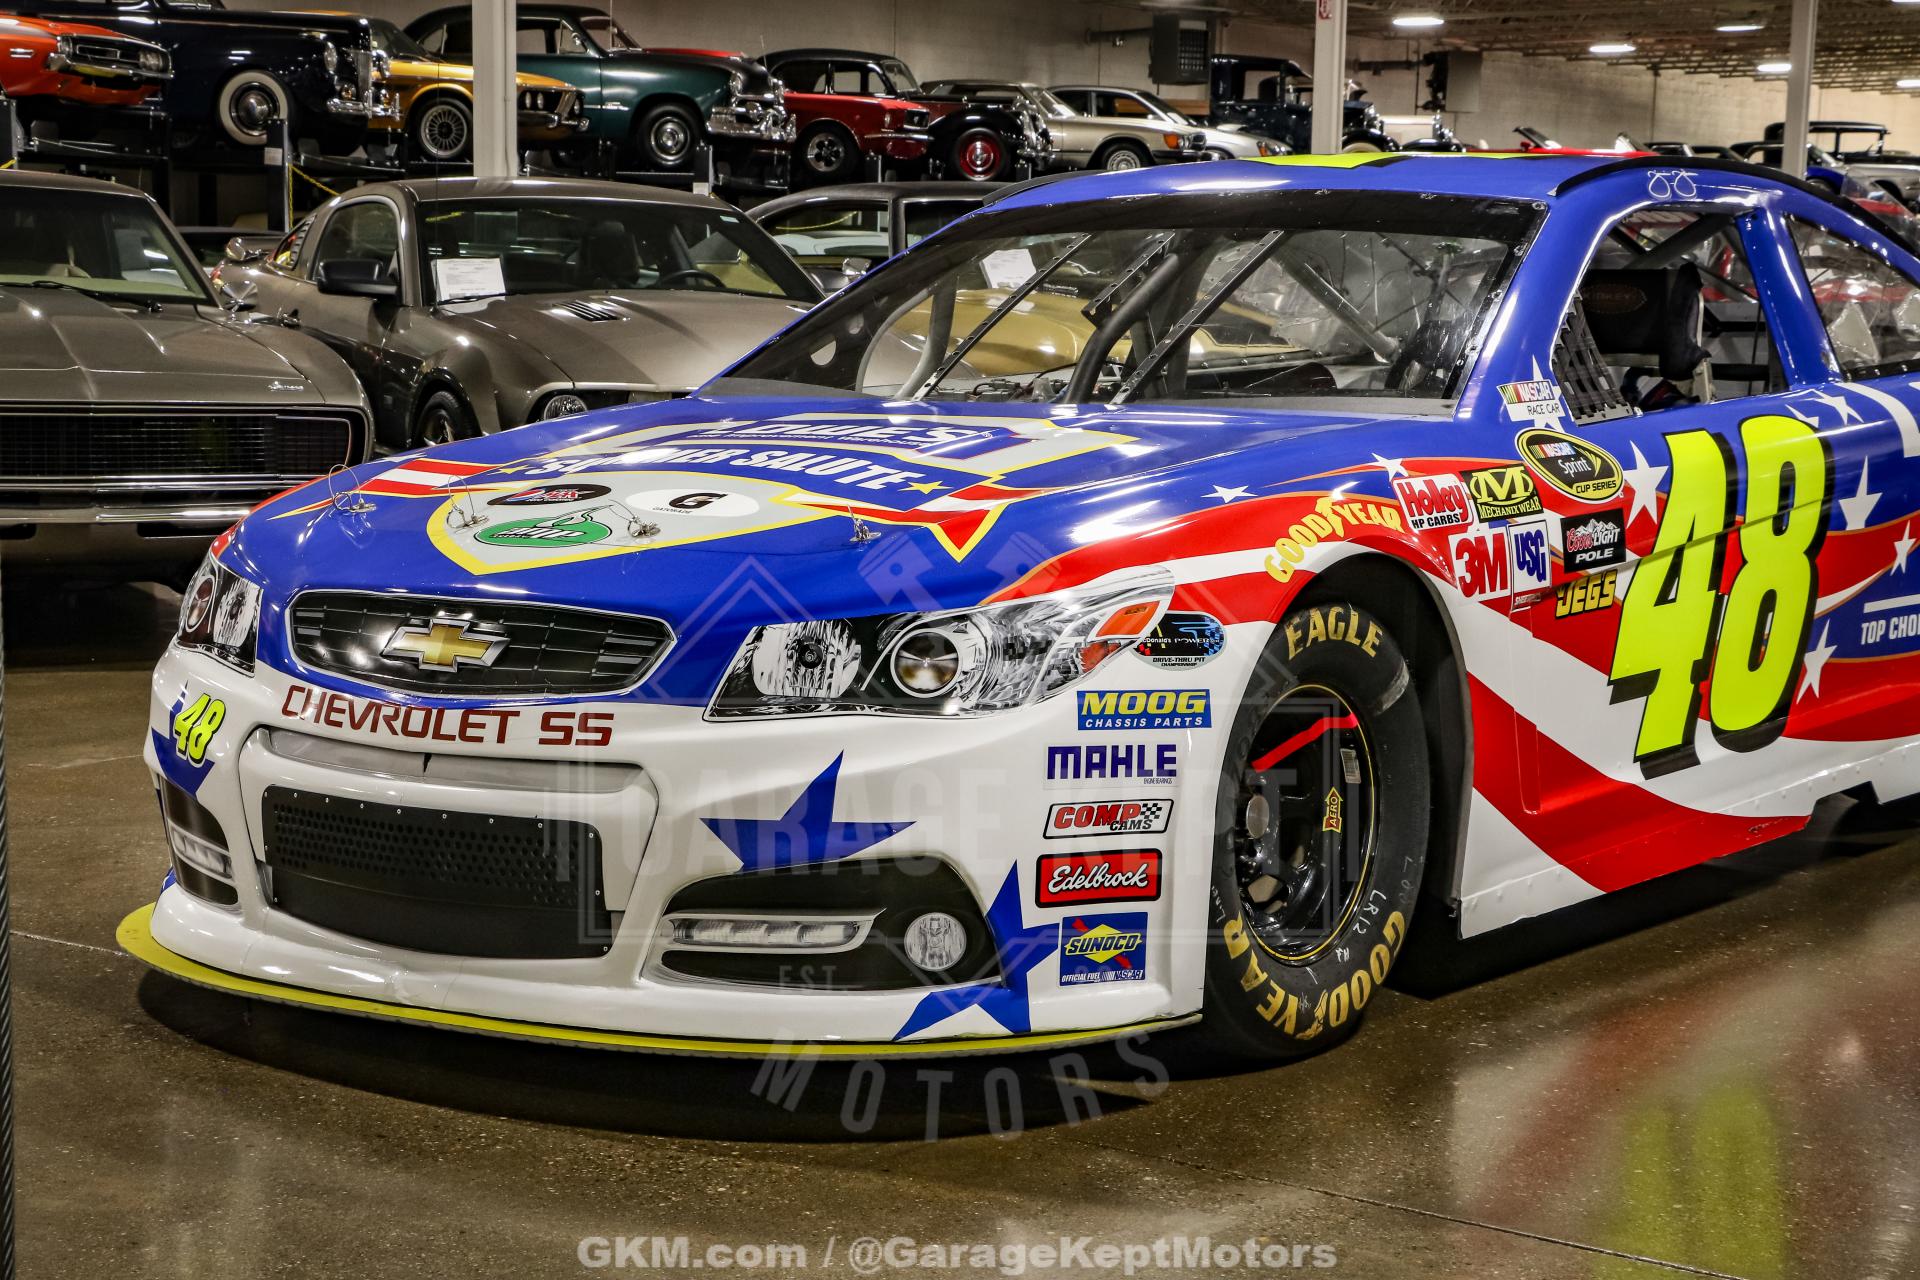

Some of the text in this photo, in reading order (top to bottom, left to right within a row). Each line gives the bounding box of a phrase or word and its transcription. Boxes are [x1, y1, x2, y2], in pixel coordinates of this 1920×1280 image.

[1521, 381, 1556, 402] NASCAR
[1527, 402, 1560, 416] RACE CAR
[1545, 441, 1577, 458] NASCAR
[729, 450, 926, 490] SALUTE
[1557, 457, 1592, 478] Sprint
[1397, 477, 1470, 522] Holley
[1575, 480, 1617, 494] CUP SERIES
[668, 492, 729, 509] G
[1478, 496, 1542, 519] MECHANIX WEAR
[1411, 513, 1461, 530] HP CARBS
[1263, 495, 1405, 584] GOODYEAR
[1566, 528, 1622, 553] Coors LIGHT
[1455, 532, 1509, 598] 3M
[1513, 529, 1547, 583] USG
[1574, 548, 1614, 565] POLE
[1608, 413, 1829, 766] 48
[1287, 606, 1384, 661] EAGLE
[1861, 619, 1886, 645] TOP
[281, 684, 614, 747] CHEVROLET SS
[1080, 690, 1208, 716] MOOG
[173, 692, 227, 765] 48
[1085, 716, 1204, 729] CHASSIS PARTS
[1046, 743, 1178, 780] MAHLE
[1052, 803, 1142, 830] COMP
[1329, 796, 1338, 827] AERO
[1109, 819, 1153, 831] CAMS
[1047, 864, 1149, 894] Edelbrock
[1065, 934, 1142, 954] SUNOCO
[1061, 973, 1087, 983] OFFICIAL
[1087, 971, 1101, 981] FUEL
[1223, 910, 1406, 1041] GOODYEAR
